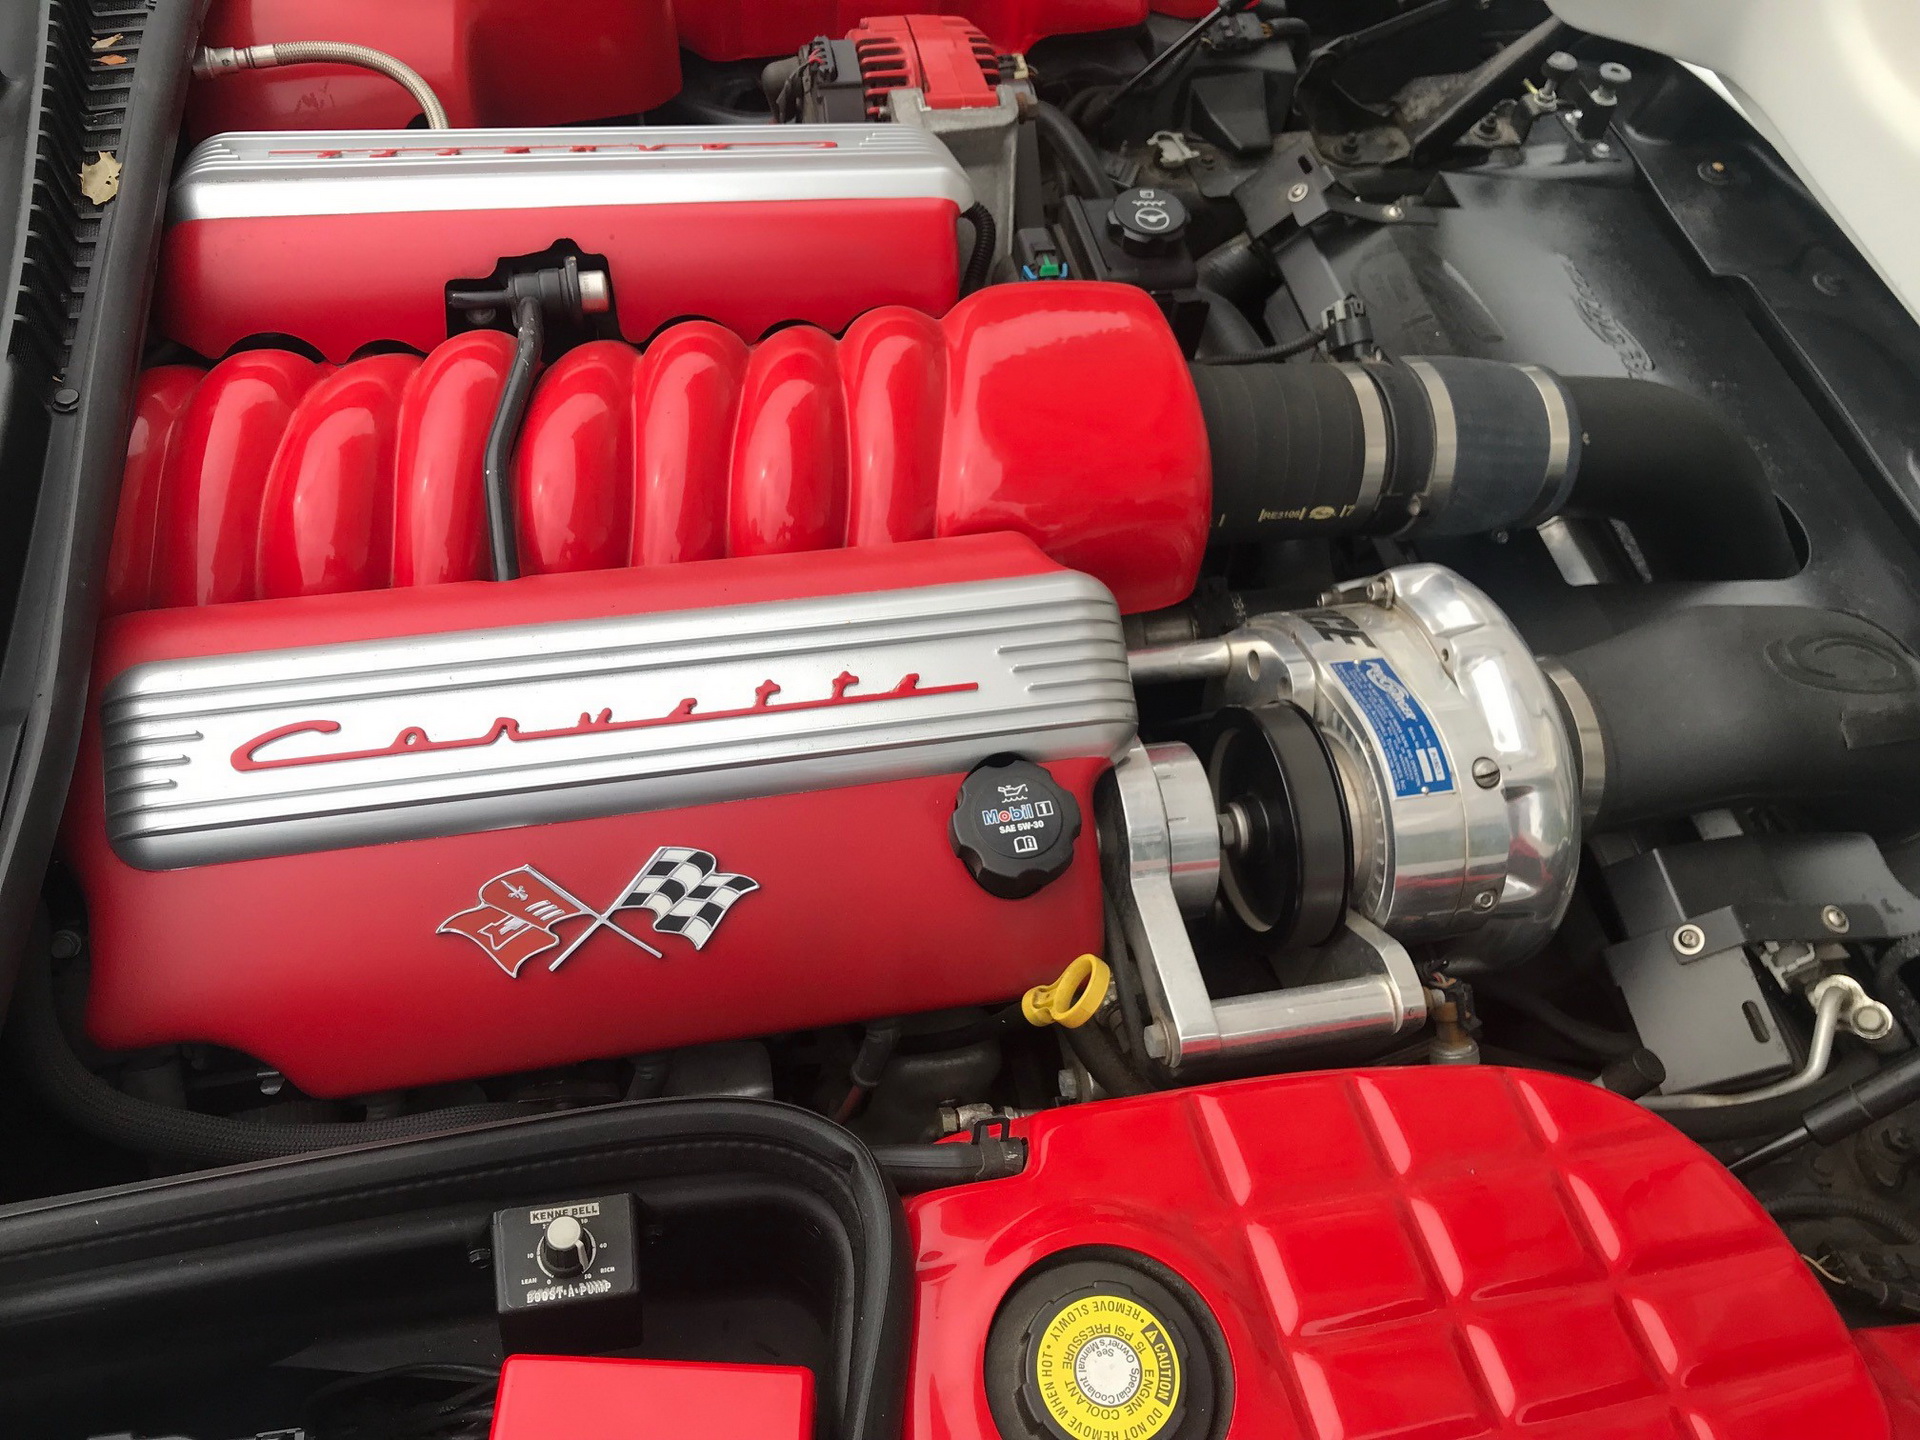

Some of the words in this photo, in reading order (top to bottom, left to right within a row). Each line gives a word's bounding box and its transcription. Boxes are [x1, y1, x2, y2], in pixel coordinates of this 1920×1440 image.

[230, 671, 978, 771] Corvette
[982, 803, 1034, 825] Mobil
[999, 825, 1017, 834] SAE
[1018, 820, 1045, 831] 5W-30
[532, 1209, 569, 1221] KENNE
[571, 1205, 598, 1216] BELL
[521, 1277, 537, 1285] LEAN
[600, 1266, 615, 1274] RICH
[1050, 1303, 1090, 1342] SLOWLY
[1092, 1300, 1141, 1320] REMOVE
[1114, 1325, 1134, 1341] PSI
[1062, 1323, 1111, 1370] PRESSURE
[1078, 1341, 1100, 1373] Manual
[1096, 1347, 1115, 1358] See
[1099, 1339, 1135, 1364] Owner's
[1134, 1341, 1147, 1355] 15
[1041, 1351, 1053, 1377] HOT
[1154, 1342, 1172, 1400] CAUTION
[1080, 1376, 1116, 1404] Coolant
[1116, 1367, 1140, 1403] Special
[1124, 1369, 1155, 1416] ENGINE
[1044, 1381, 1069, 1419] WHEN
[1064, 1380, 1120, 1420] COOLANT
[1067, 1415, 1119, 1440] REMOVE
[1146, 1407, 1163, 1426] DO
[1124, 1421, 1148, 1440] NOT
